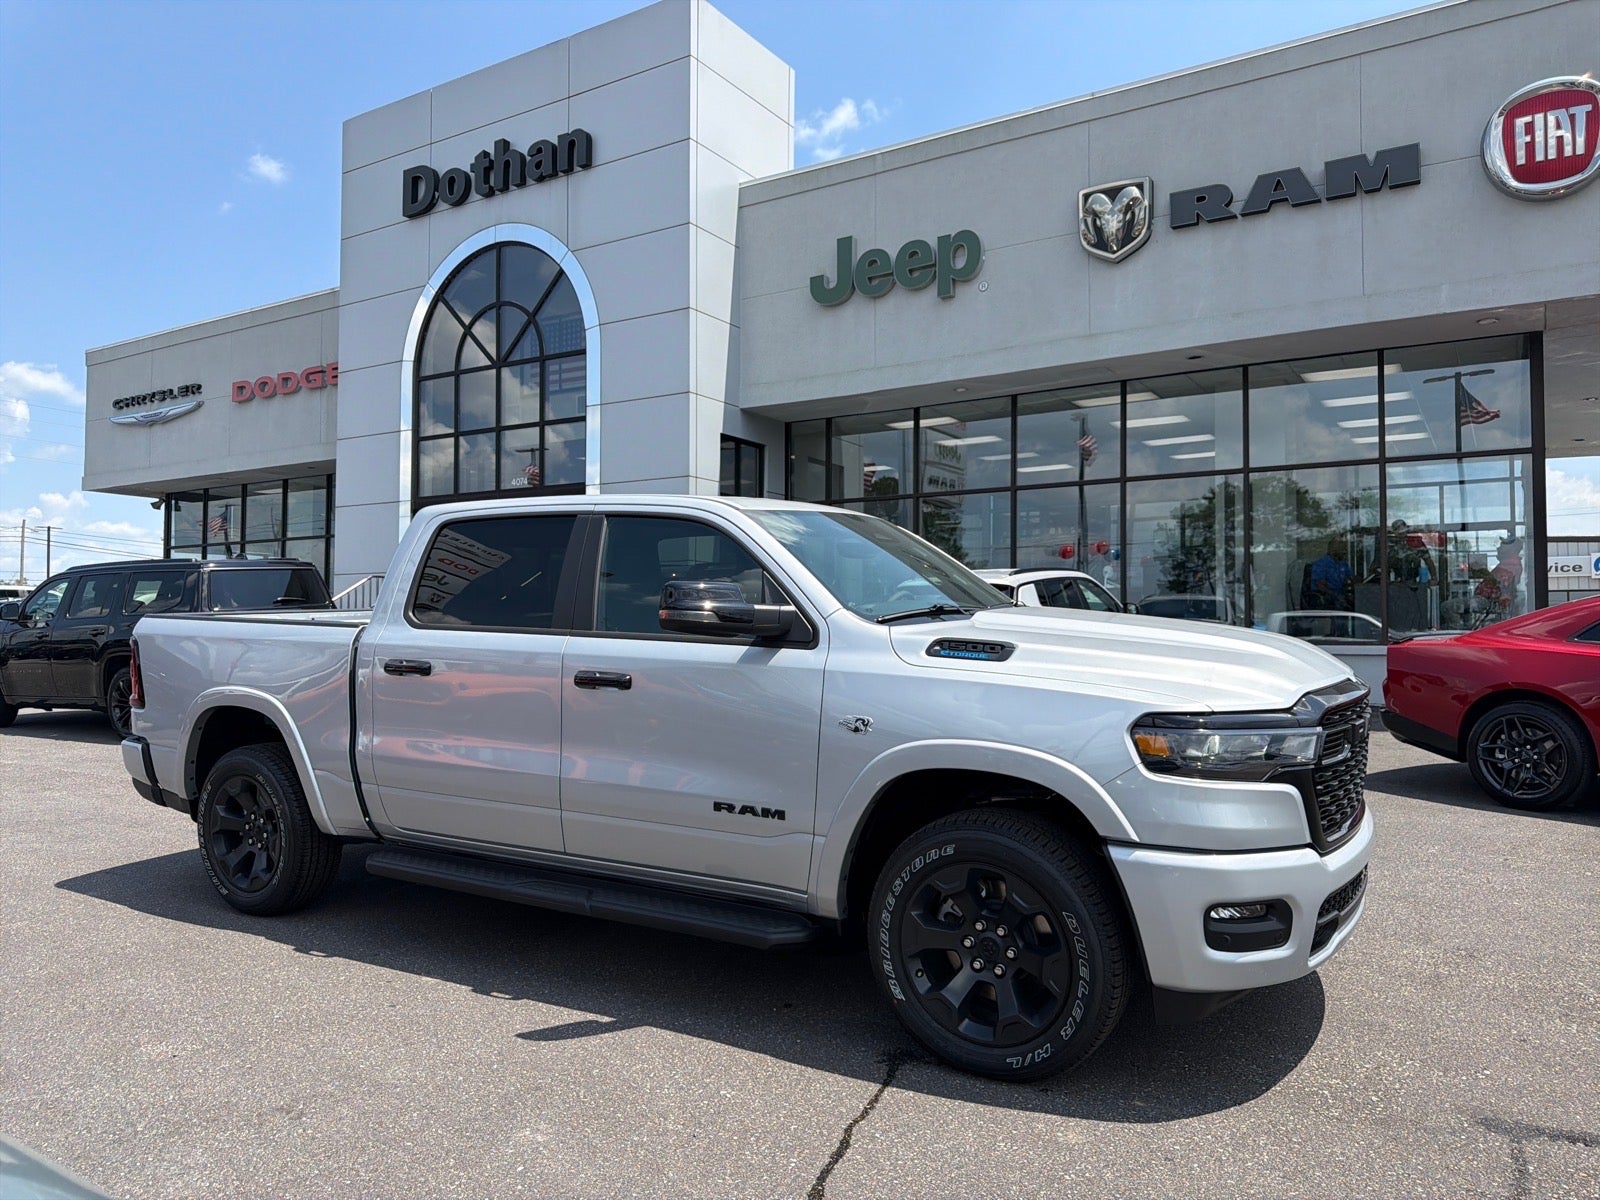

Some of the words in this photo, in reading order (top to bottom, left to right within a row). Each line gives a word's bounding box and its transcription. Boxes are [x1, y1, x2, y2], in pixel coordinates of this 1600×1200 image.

[1513, 103, 1593, 167] FIAT
[402, 127, 593, 219] Dothan
[1169, 142, 1421, 230] RAM
[809, 229, 986, 306] Jeep
[112, 383, 203, 410] CHRYSLER
[231, 361, 339, 404] DODGE
[511, 477, 528, 487] 4074
[938, 641, 1003, 653] 1500
[713, 800, 786, 821] RAM
[879, 843, 956, 1002] BRIDGESTONE
[1060, 910, 1091, 1041] DUELER
[1006, 1042, 1055, 1069] H/L
